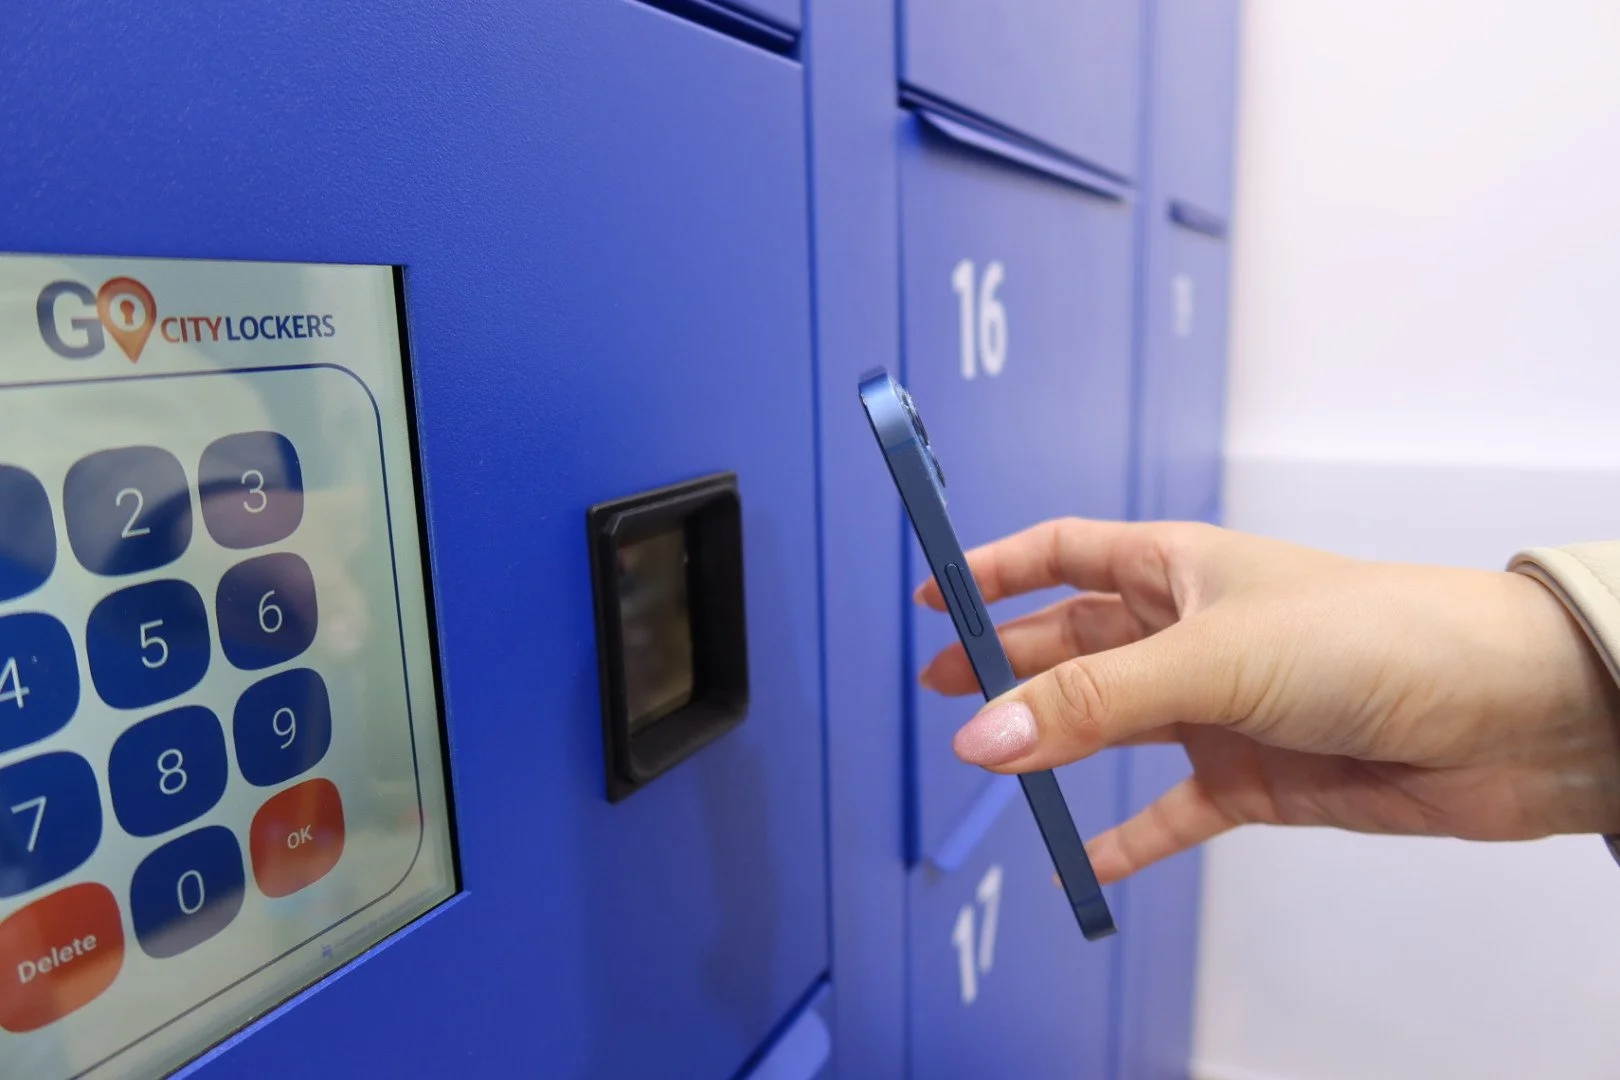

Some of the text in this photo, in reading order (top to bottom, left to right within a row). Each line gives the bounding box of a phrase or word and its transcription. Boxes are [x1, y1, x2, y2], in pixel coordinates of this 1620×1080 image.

[952, 257, 1008, 381] 16
[115, 487, 151, 539] 2
[240, 469, 267, 513] 3
[258, 590, 283, 633] 6
[139, 619, 169, 668] 5
[0, 656, 30, 709] 4
[272, 707, 297, 750] 9
[156, 748, 188, 796] 8
[11, 796, 47, 853] 7
[287, 824, 313, 850] OK
[176, 869, 205, 915] 0
[17, 933, 97, 984] Delete
[953, 863, 1003, 1006] 17
